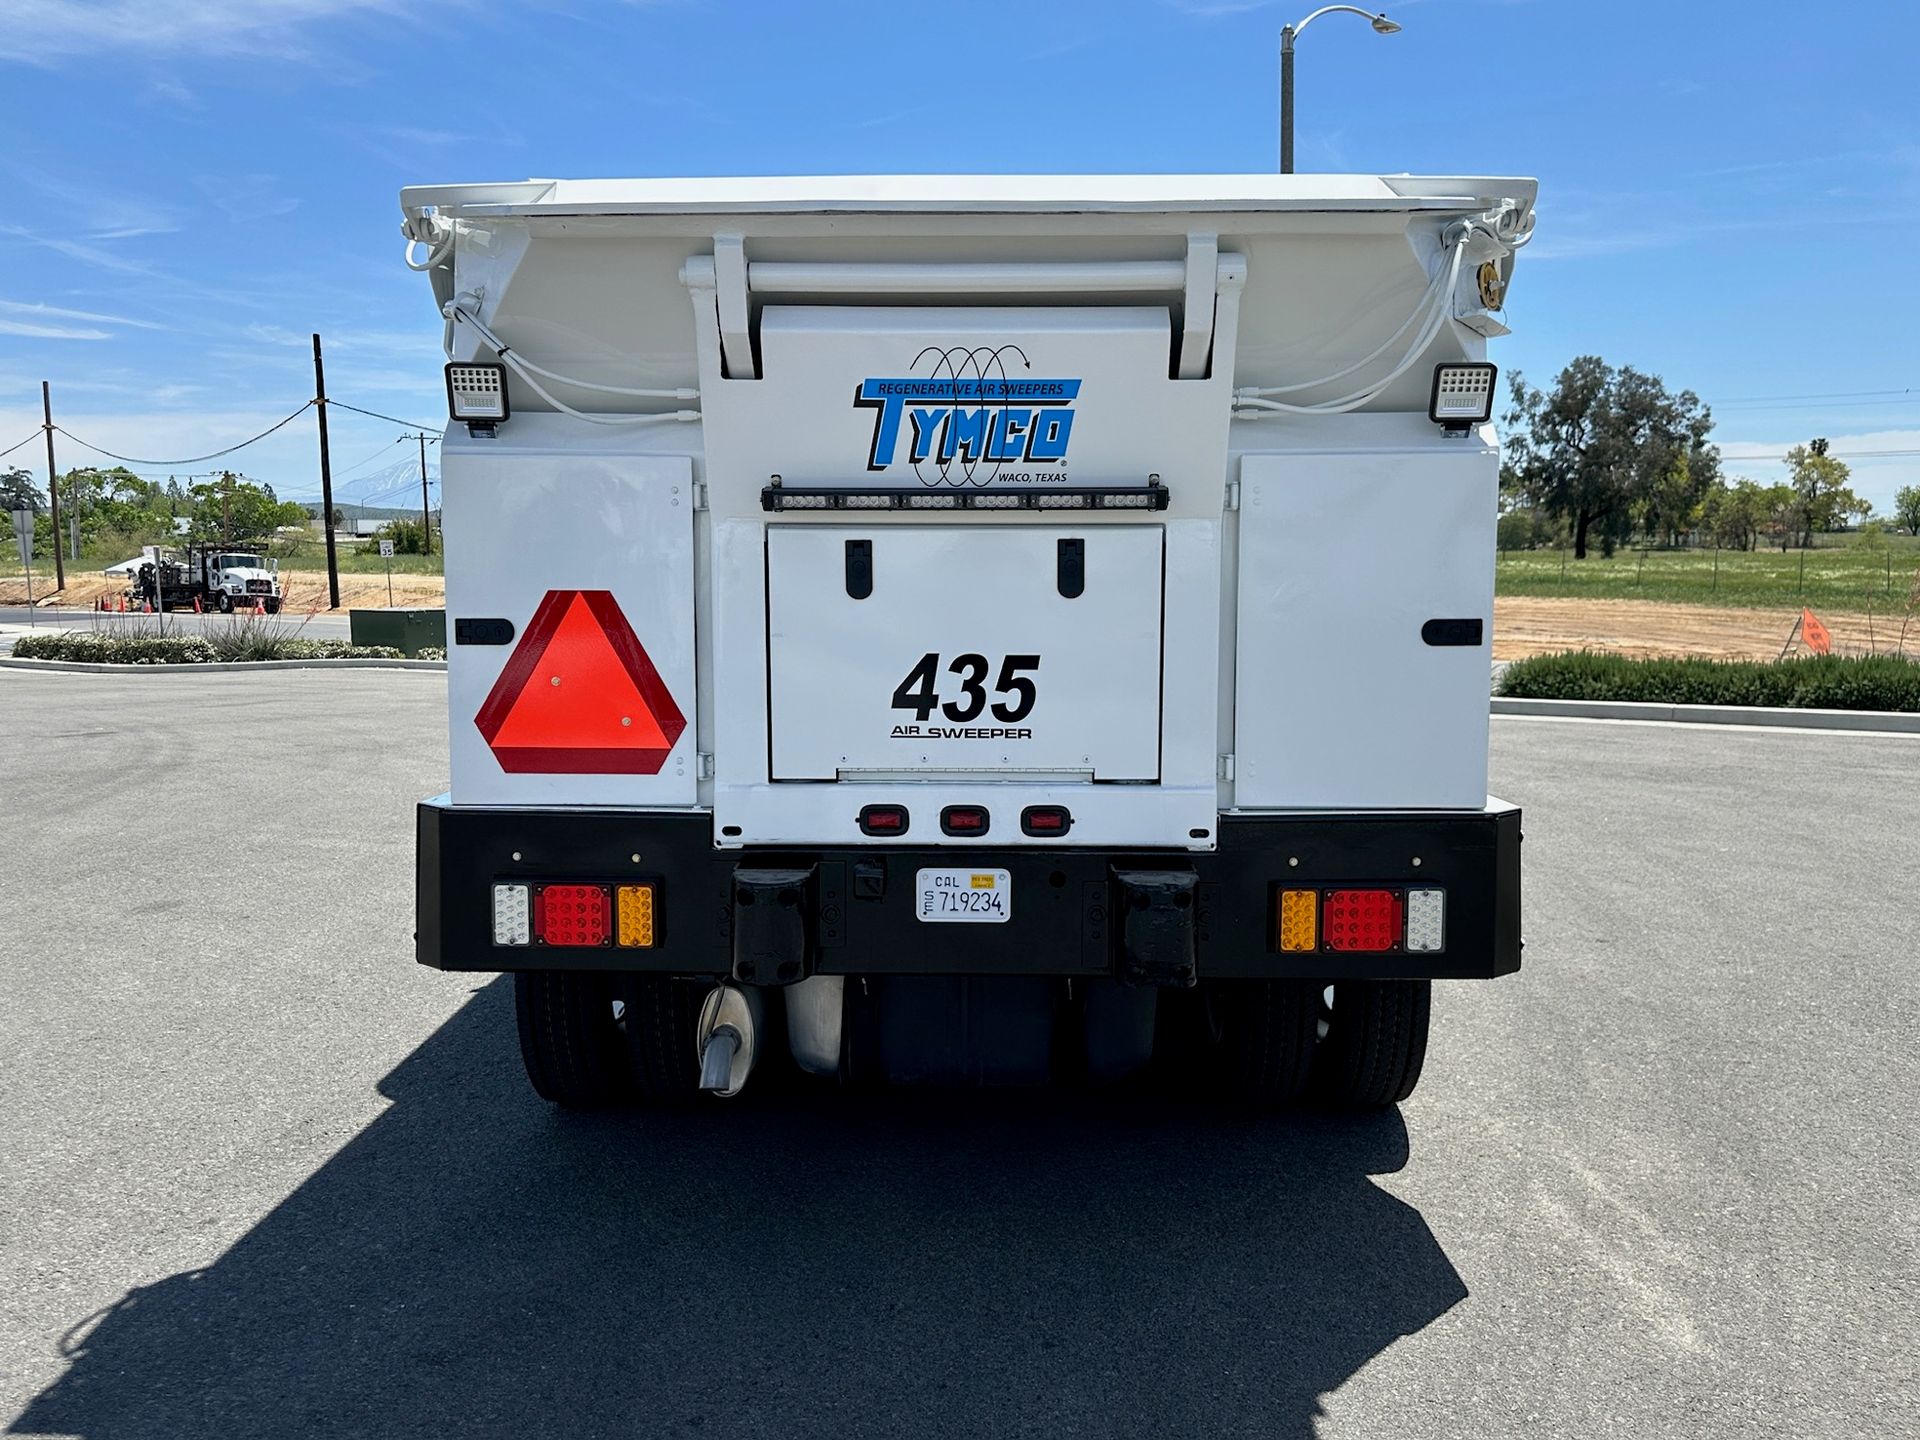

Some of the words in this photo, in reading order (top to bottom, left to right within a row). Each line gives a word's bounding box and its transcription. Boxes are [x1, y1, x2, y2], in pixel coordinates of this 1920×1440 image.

[878, 383, 974, 395] REGENERATIVE
[975, 383, 996, 395] AIR
[998, 383, 1064, 395] SWEEPERS
[853, 378, 1082, 471] TYMCO
[998, 473, 1032, 483] WACO,
[1035, 473, 1067, 482] TEXAS
[382, 548, 393, 556] 35
[891, 653, 1041, 723] 435
[891, 725, 920, 735] AIR
[928, 728, 1032, 739] SWEEPER
[935, 876, 960, 888] CAL
[924, 890, 934, 912] SE
[939, 891, 1002, 912] 719234
